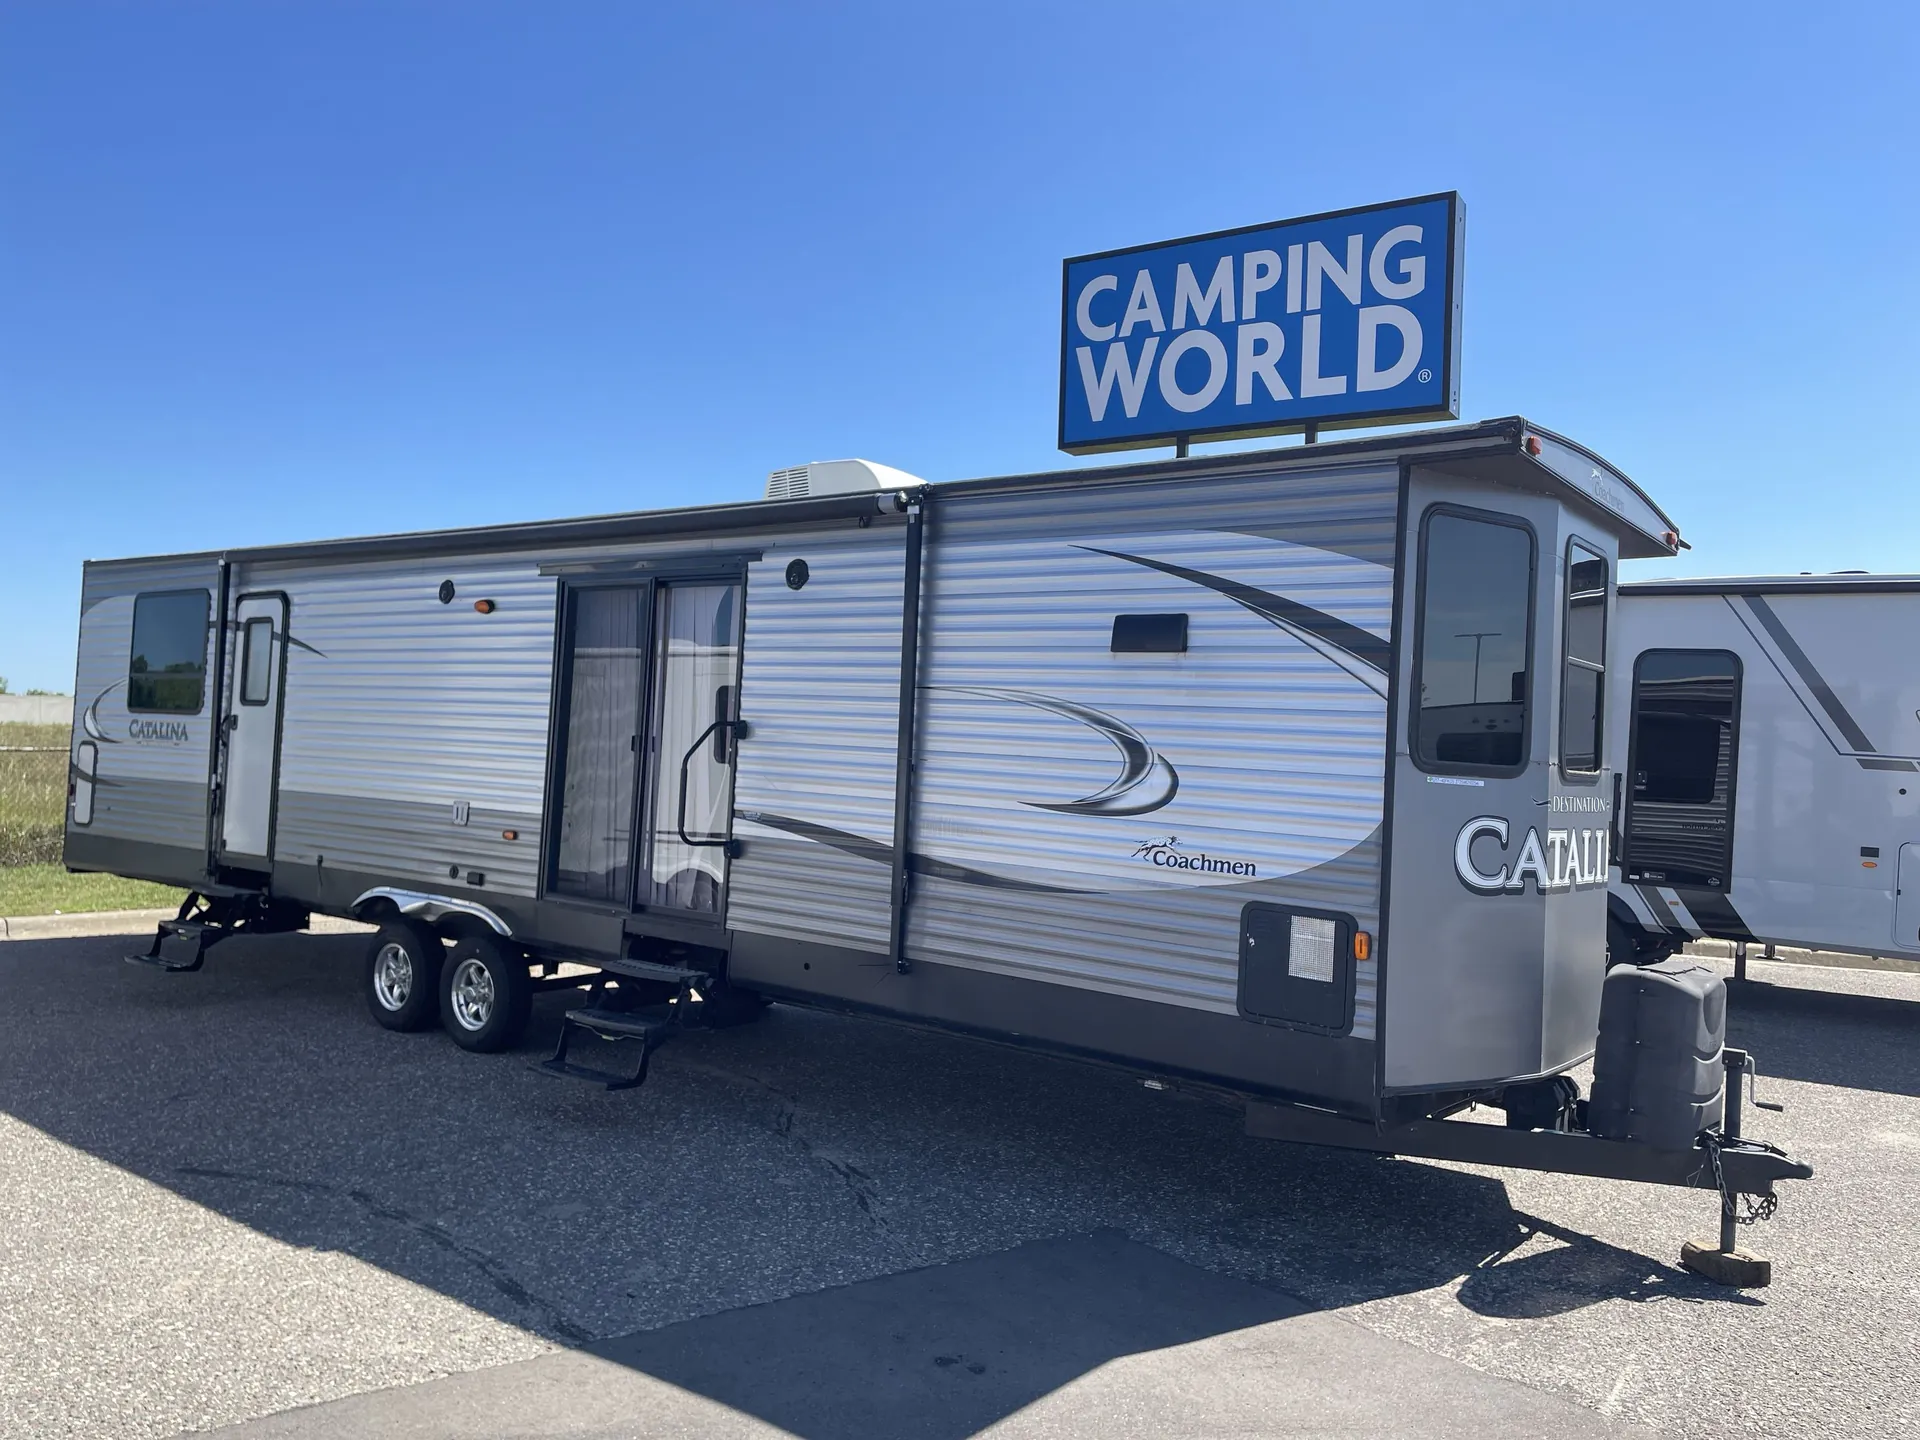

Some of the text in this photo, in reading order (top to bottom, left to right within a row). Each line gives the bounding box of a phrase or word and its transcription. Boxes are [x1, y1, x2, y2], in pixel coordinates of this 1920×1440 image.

[1076, 225, 1426, 342] CAMPING
[1075, 305, 1424, 422] WORLD
[129, 719, 188, 741] CATALINA
[1552, 795, 1607, 813] DESTINATION
[1152, 850, 1257, 877] Coachmen
